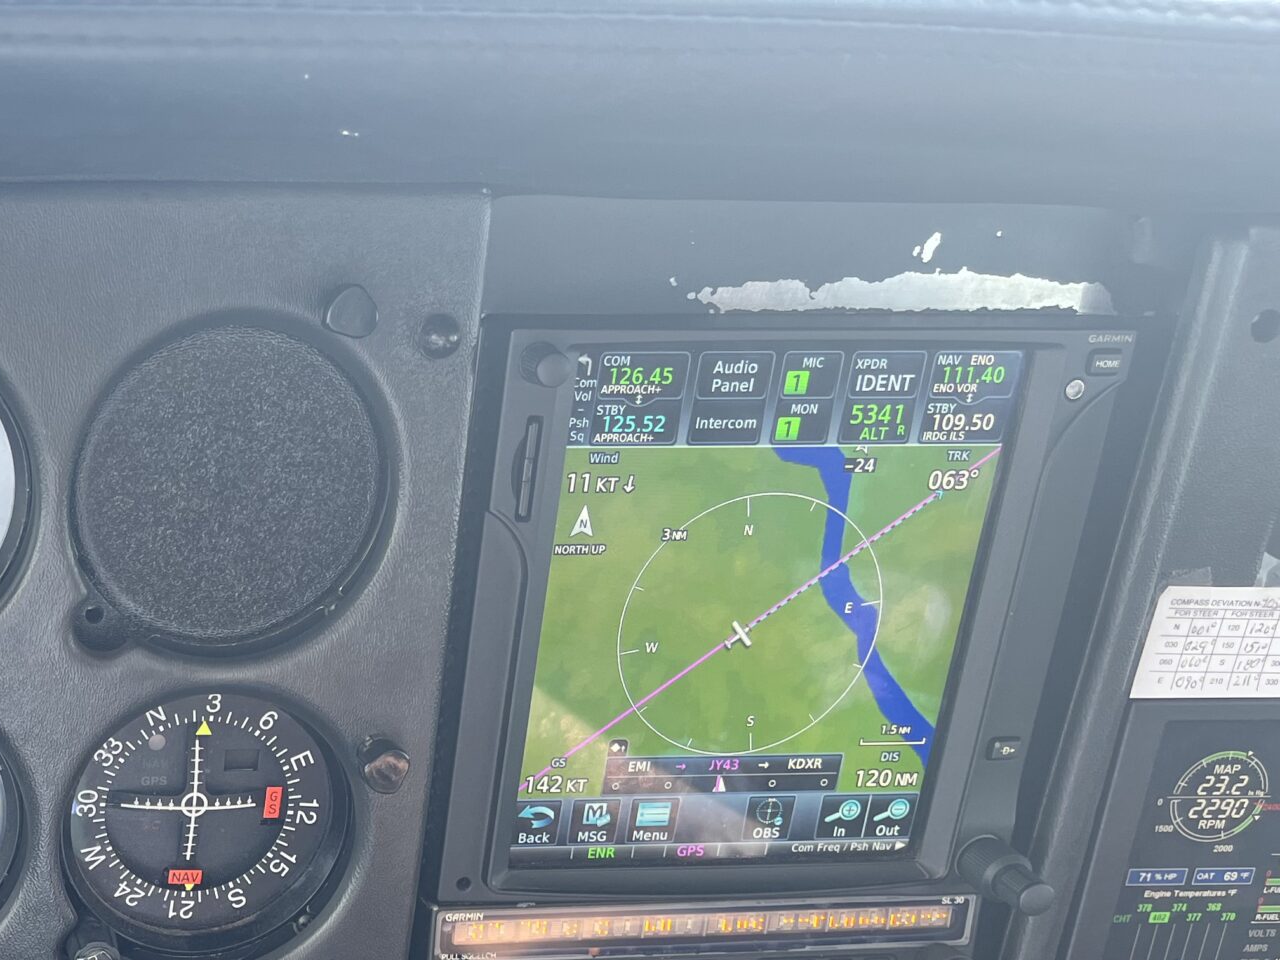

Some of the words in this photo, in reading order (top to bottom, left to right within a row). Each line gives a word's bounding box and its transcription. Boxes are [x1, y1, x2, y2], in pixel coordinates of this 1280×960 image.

[604, 356, 630, 366] COM
[802, 357, 824, 368] MIC
[856, 359, 888, 370] XPDR
[938, 355, 962, 365] NAV
[971, 355, 994, 365] ENO
[713, 361, 758, 374] Audio
[610, 368, 673, 385] 126.45
[943, 367, 1005, 383] 111.40
[712, 379, 754, 392] Panel
[855, 374, 915, 392] IDENT
[933, 384, 956, 393] ENO
[957, 384, 977, 393] VOR
[601, 385, 662, 394] APPROACH+
[596, 405, 626, 415] STBY
[791, 404, 818, 414] MON
[927, 403, 957, 414] STBY
[850, 404, 905, 425] 5341
[603, 415, 666, 433] 125.52
[695, 417, 757, 429] Intercom
[932, 414, 994, 431] 109.50
[593, 433, 654, 443] APPROACH+
[860, 427, 889, 440] ALT
[923, 432, 947, 441] IRDG
[950, 432, 965, 440] ILS
[590, 453, 619, 463] Wind
[948, 451, 969, 461] TRK
[568, 473, 591, 493] 11
[596, 478, 619, 493] KT
[554, 545, 588, 555] NORTH
[590, 545, 606, 555] UP
[880, 752, 899, 762] DIS
[628, 762, 651, 772] EMI
[708, 759, 739, 771] JY43
[787, 758, 823, 769] KDXR
[1214, 764, 1241, 775] MAP
[856, 770, 892, 787] 120
[895, 773, 918, 786] NM
[526, 776, 563, 793] 142
[566, 779, 587, 792] KT
[1197, 775, 1248, 795] 23.2
[1188, 799, 1248, 818] 2290
[1198, 820, 1226, 830] RPM
[577, 831, 607, 842] MSG
[632, 831, 667, 841] Menu
[753, 828, 780, 839] OBS
[876, 826, 900, 836] Out
[518, 833, 550, 843] Back
[588, 848, 615, 858] ENR
[677, 845, 704, 856] GPS
[172, 871, 199, 883] NAV
[1144, 889, 1171, 899] Engine
[1173, 889, 1227, 898] Temperatures
